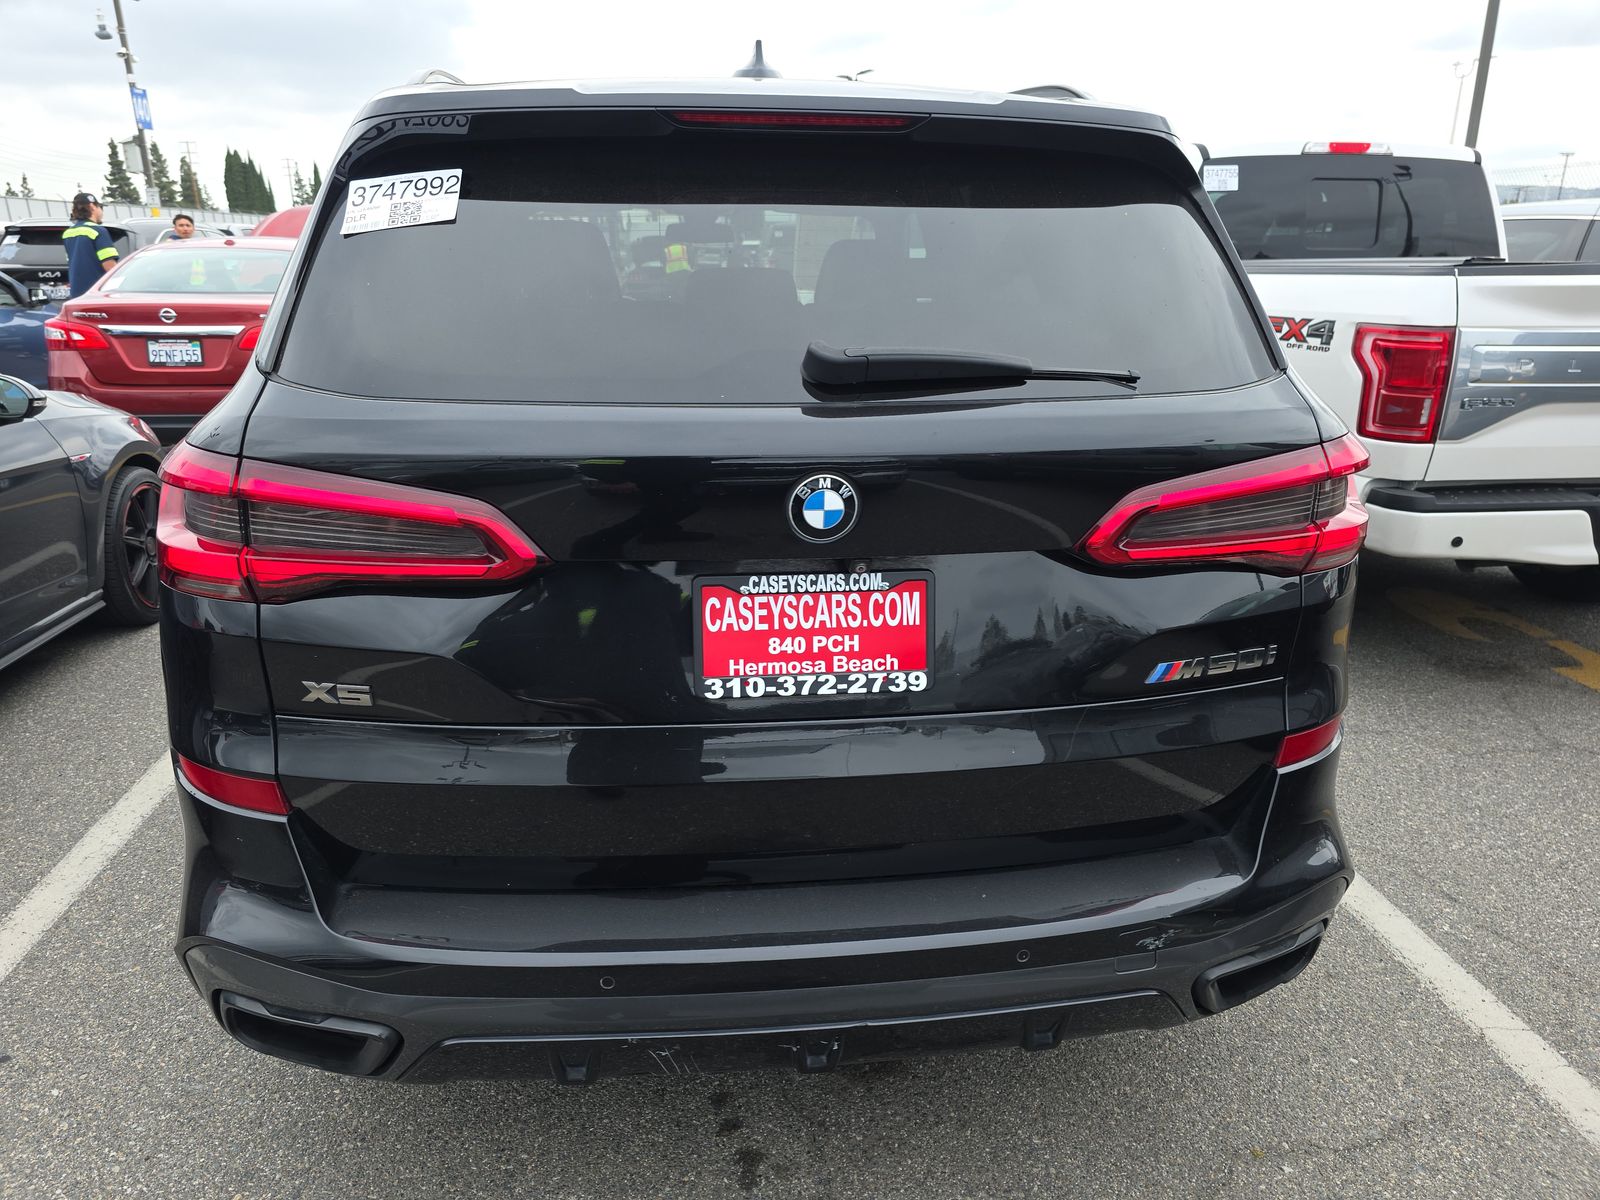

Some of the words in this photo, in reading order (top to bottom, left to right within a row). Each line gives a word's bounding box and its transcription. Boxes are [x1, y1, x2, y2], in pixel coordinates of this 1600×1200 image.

[351, 174, 461, 208] 3747992
[345, 213, 367, 224] DLR
[1286, 342, 1304, 350] OFF
[1306, 344, 1331, 353] ROAD
[796, 477, 853, 501] BMW
[748, 572, 883, 594] CASEYSCARS.COM
[704, 591, 921, 633] CASEYSCARS.COM
[767, 636, 806, 655] 840
[812, 634, 860, 653] PCH
[728, 657, 827, 676] Hermosa
[832, 653, 899, 673] Beach
[301, 680, 374, 706] X5
[703, 671, 928, 699] 310-372-2739
